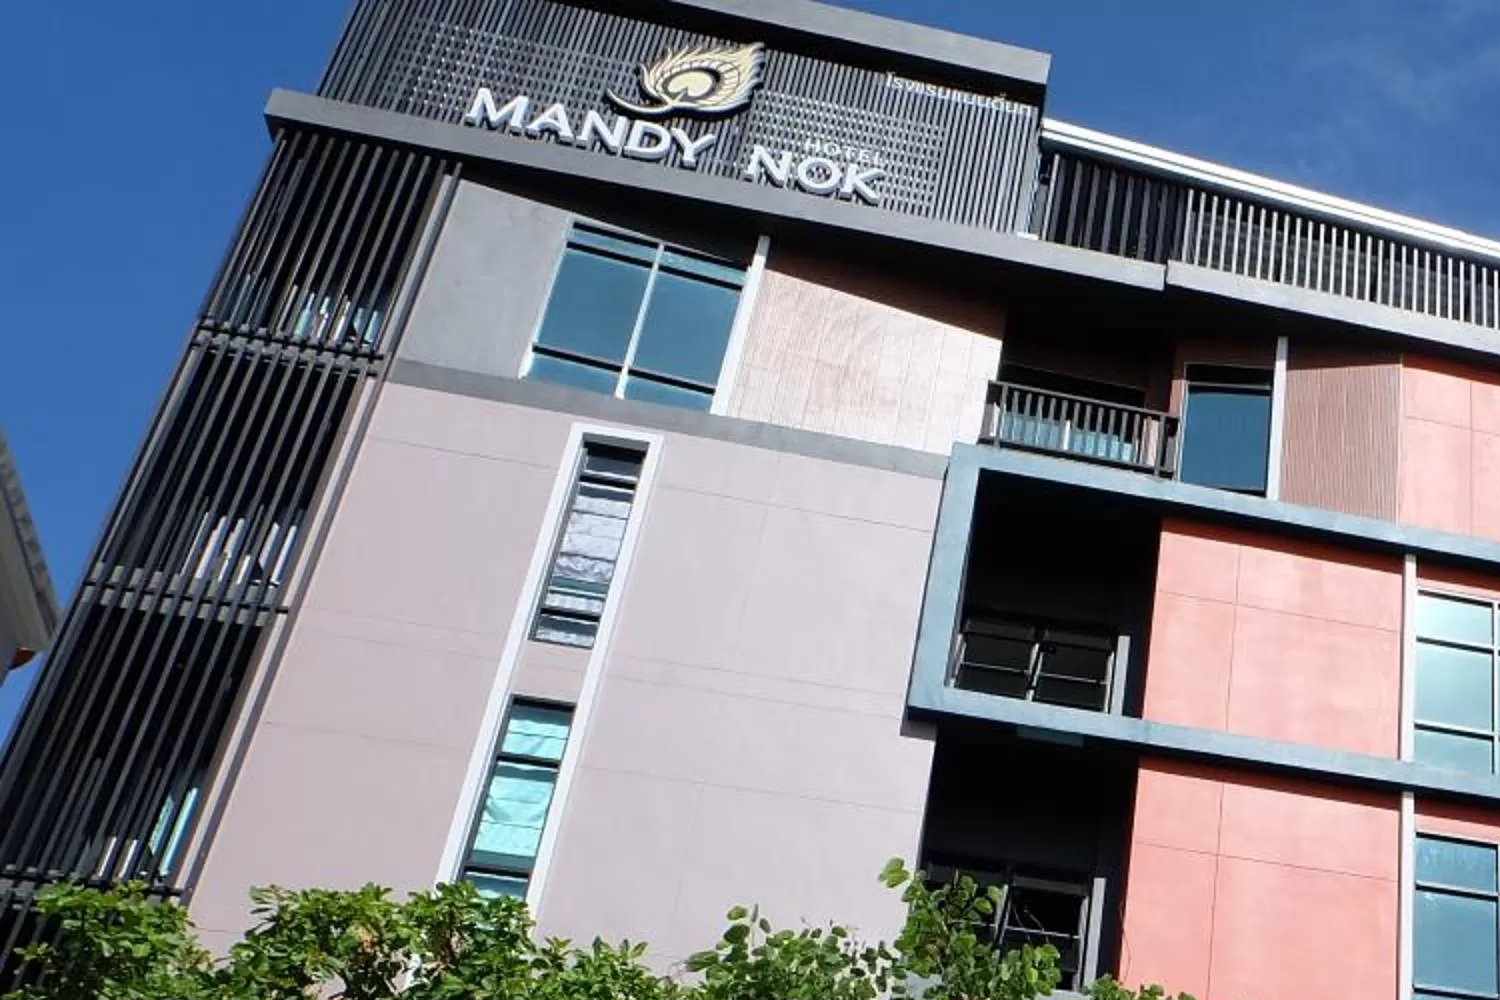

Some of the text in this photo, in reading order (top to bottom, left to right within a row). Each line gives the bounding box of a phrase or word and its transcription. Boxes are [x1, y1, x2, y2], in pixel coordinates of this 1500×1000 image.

[464, 87, 886, 204] MANDY NOK
[803, 139, 881, 165] HOTEL
